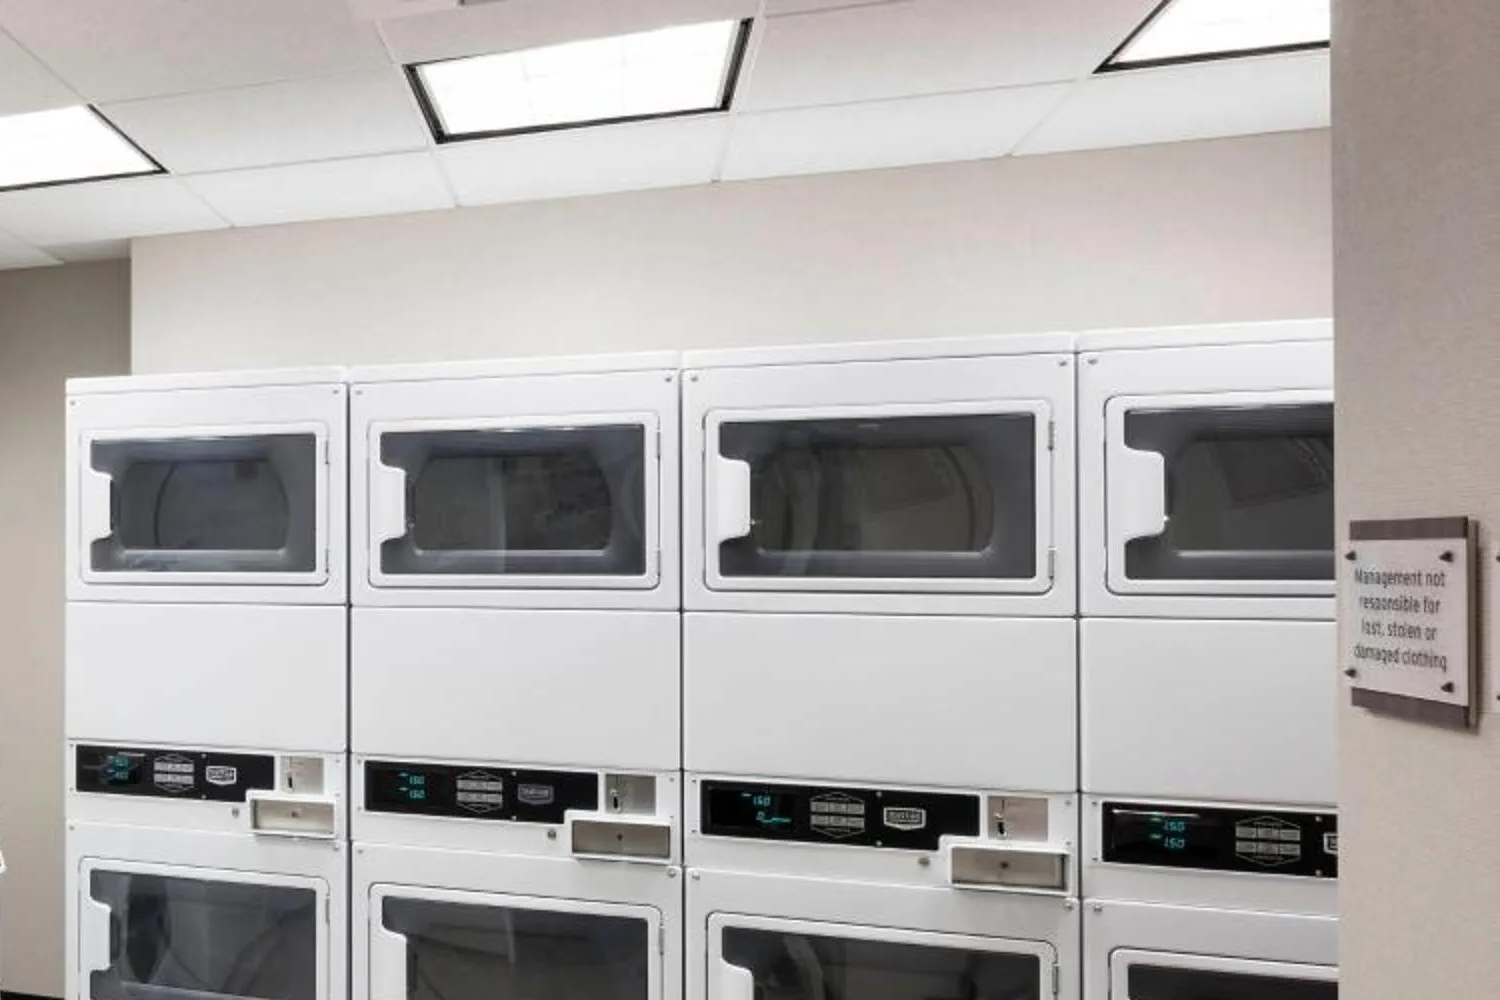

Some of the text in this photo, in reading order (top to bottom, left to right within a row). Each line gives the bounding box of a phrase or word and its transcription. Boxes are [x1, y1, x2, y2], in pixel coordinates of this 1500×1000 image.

[1354, 568, 1445, 589] Management not
[1359, 594, 1441, 614] responsible for
[1387, 621, 1421, 639] stolen
[1425, 627, 1437, 641] or
[1354, 643, 1400, 664] damaged
